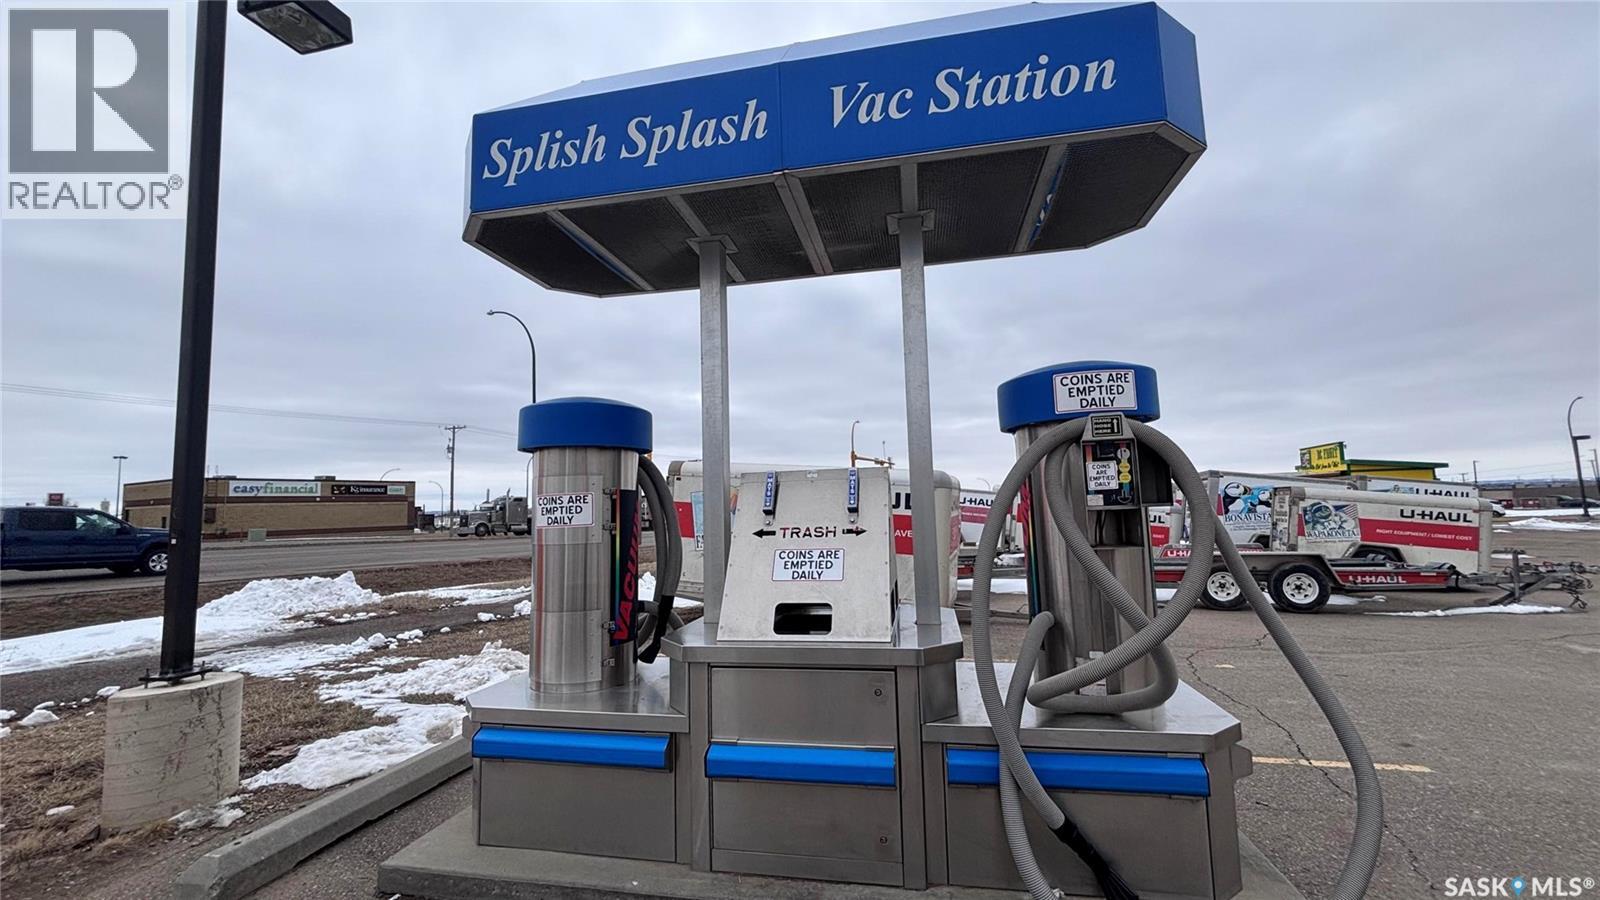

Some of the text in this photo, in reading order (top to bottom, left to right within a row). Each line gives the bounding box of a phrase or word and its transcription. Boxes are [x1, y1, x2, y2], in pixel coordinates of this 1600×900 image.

[830, 54, 1117, 129] Vac Station
[482, 98, 769, 187] Splish Splash
[1060, 372, 1130, 387] COINS ARE
[1068, 384, 1125, 398] EMPTIED
[1080, 396, 1116, 409] DAILY
[233, 482, 319, 497] easyfinancial
[538, 495, 589, 506] COINS ARE
[959, 497, 995, 507] U-HAU
[541, 505, 583, 516] EMPTIED
[1400, 509, 1472, 523] U-HAUL
[547, 516, 574, 526] DAILY
[780, 526, 837, 539] TRASH
[778, 550, 840, 560] COINS ARE
[784, 560, 834, 570] EMPTIED
[792, 570, 824, 580] DAILY
[1348, 576, 1407, 584] U-HAUL
